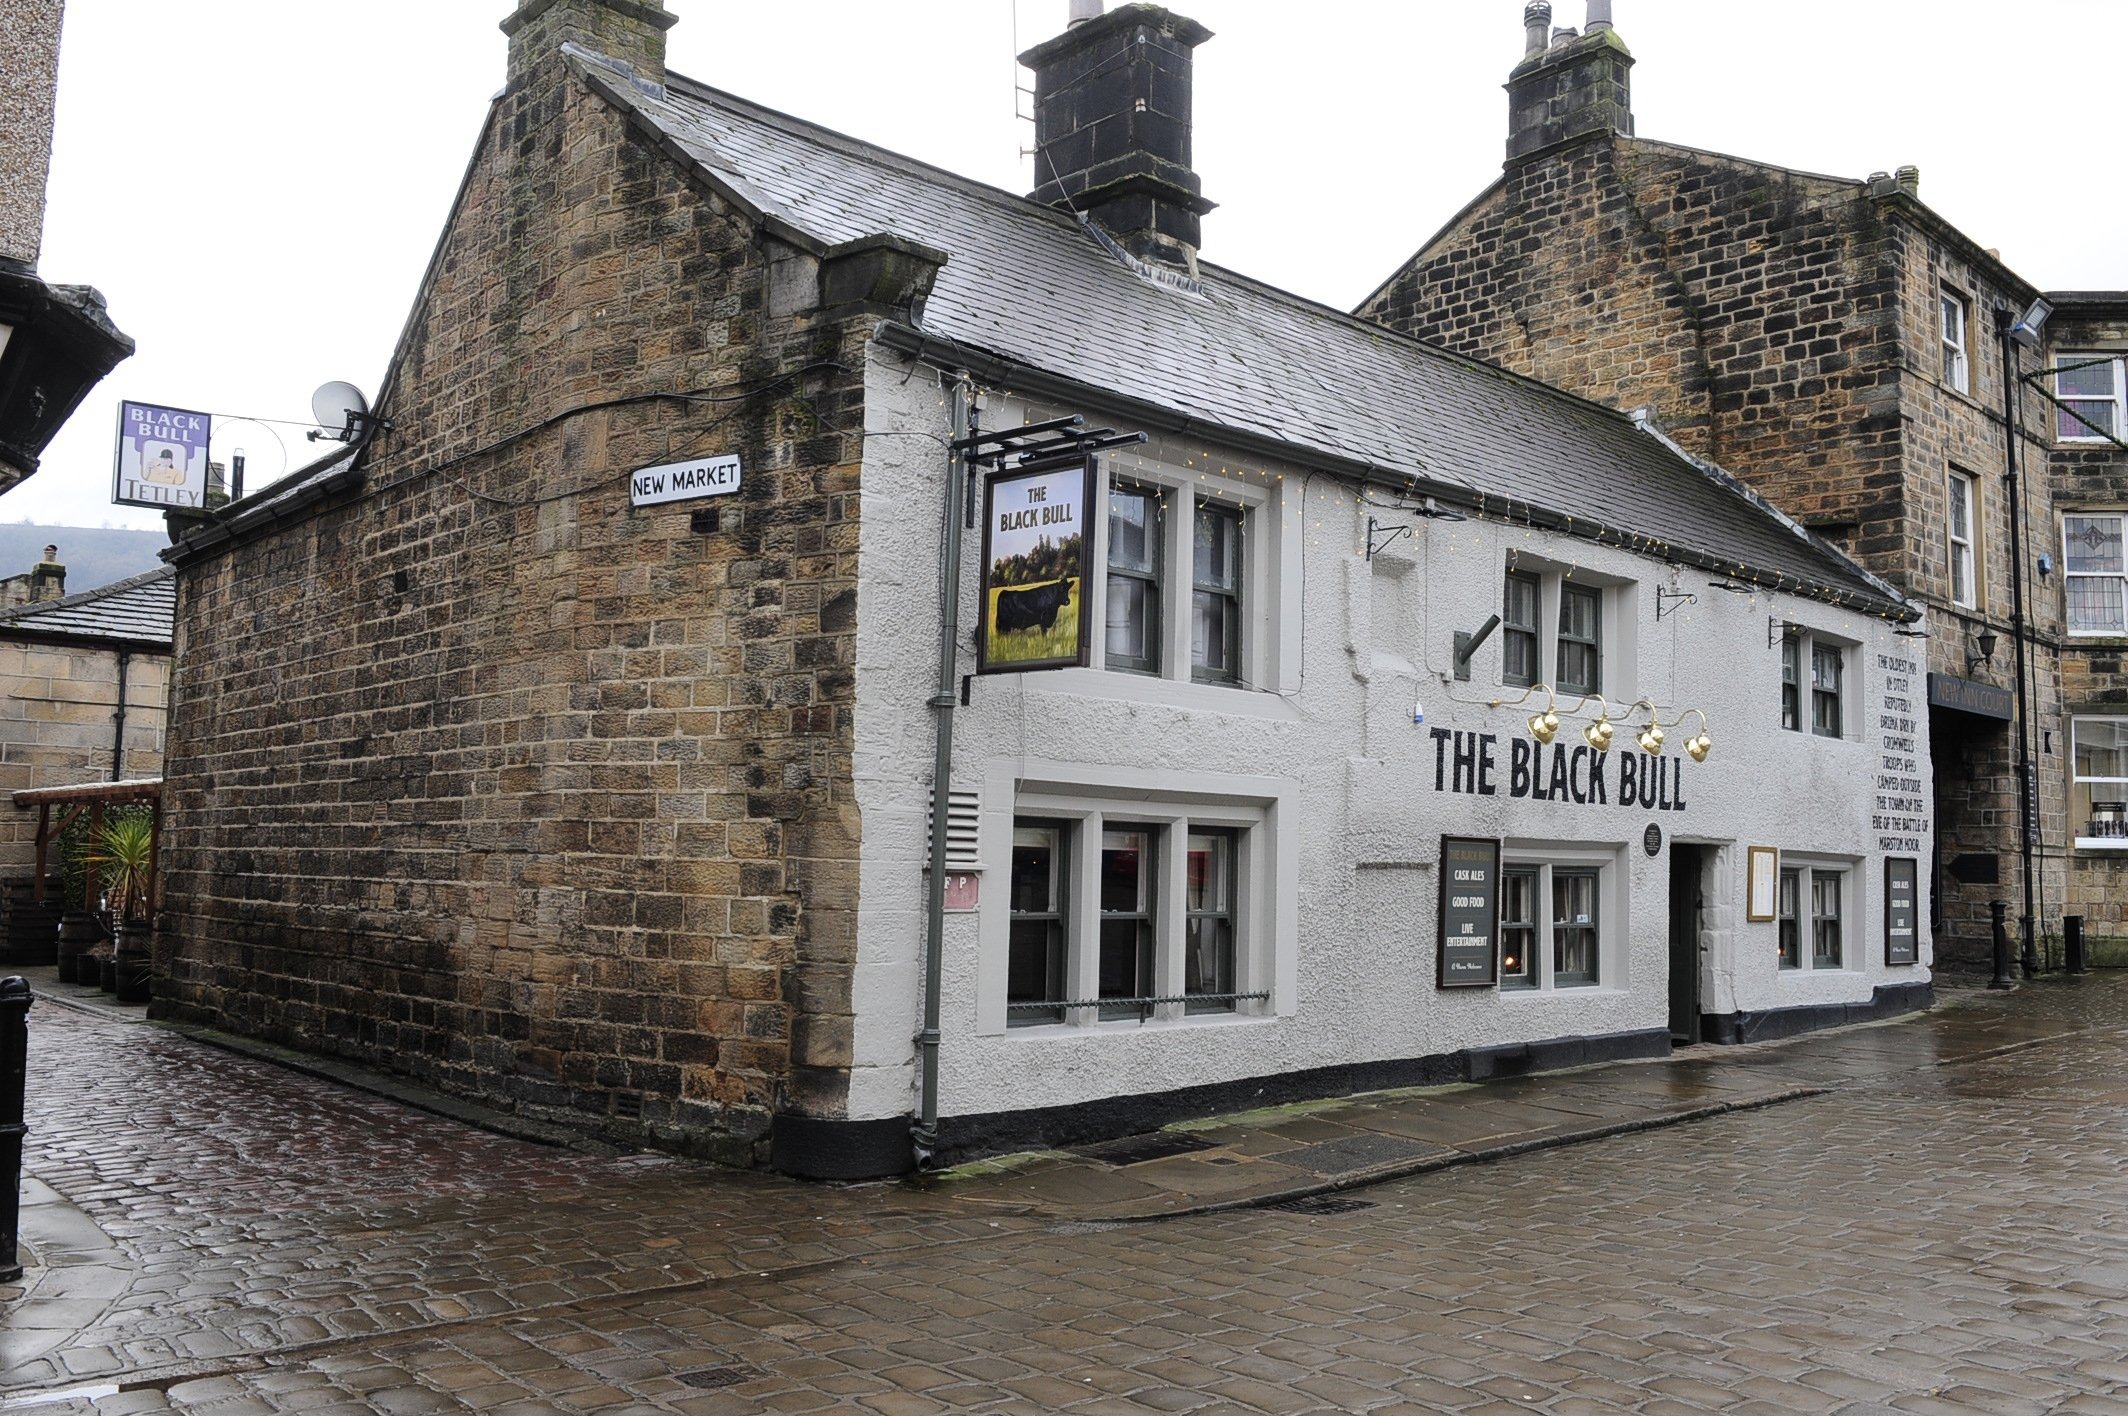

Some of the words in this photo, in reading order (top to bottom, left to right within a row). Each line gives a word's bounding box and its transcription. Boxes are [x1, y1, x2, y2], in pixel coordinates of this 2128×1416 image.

[131, 408, 200, 430] BLACK
[139, 423, 192, 442] BULL
[633, 474, 665, 497] NEW
[672, 463, 737, 491] MARKET
[125, 479, 200, 505] TETLEY
[1027, 486, 1047, 504] THE
[1000, 508, 1038, 532] BLACK
[1042, 503, 1072, 526] BULL
[1878, 654, 1888, 669] THE
[1889, 657, 1907, 673] OLDEST
[1938, 682, 1959, 702] NEW
[1961, 687, 1978, 707] INN
[1981, 691, 2008, 712] COURT
[1430, 726, 1497, 796] THE
[1510, 738, 1608, 805] BLACK
[1619, 750, 1686, 811] BULL
[1883, 756, 1903, 771] TROOPS
[1877, 775, 1899, 790] CAMPED
[1900, 778, 1921, 793] OUTSIDE
[1877, 796, 1886, 810] THE
[1914, 799, 1923, 812] THE
[1872, 816, 1882, 829] EVE
[1883, 816, 1890, 830] OF
[1892, 817, 1901, 830] THE
[1903, 818, 1920, 832] BATTLE
[1922, 819, 1928, 832] OF
[959, 877, 967, 889] P
[1454, 870, 1469, 881] CASK
[1471, 870, 1485, 881] ALES
[1452, 897, 1468, 908] GOOD
[1469, 897, 1485, 908] FOOD
[1461, 923, 1474, 934] LIVE
[1447, 936, 1488, 947] ENTERTAINMENT
